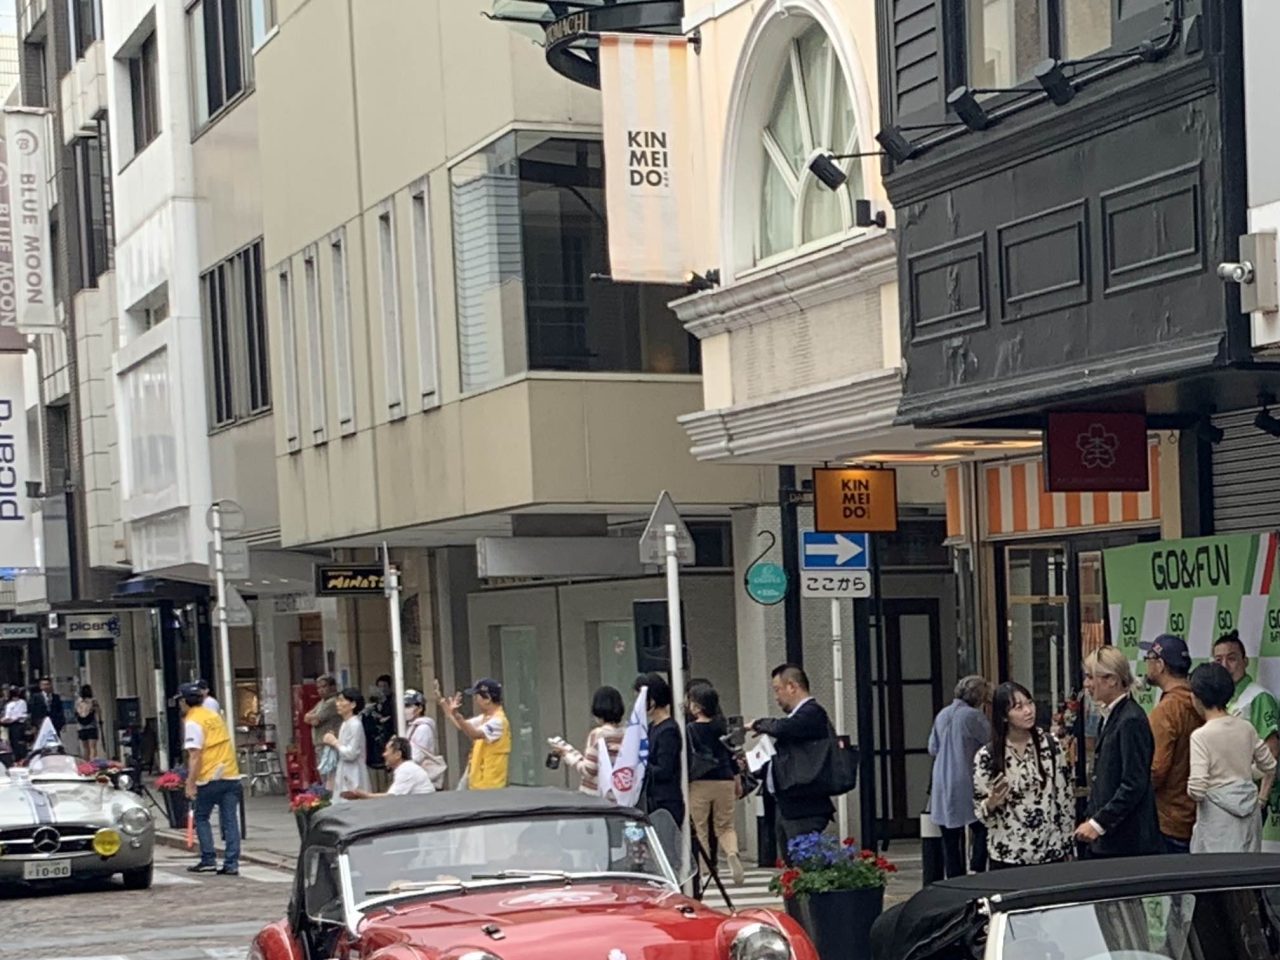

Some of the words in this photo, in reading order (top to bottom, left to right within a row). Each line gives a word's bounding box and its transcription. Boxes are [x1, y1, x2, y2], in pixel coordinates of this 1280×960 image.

[627, 131, 667, 148] KIN
[629, 151, 668, 168] MEI
[630, 170, 662, 187] DO
[20, 173, 38, 225] BLUE
[24, 235, 44, 304] MOON
[0, 261, 15, 327] MOON
[841, 479, 869, 492] KIN
[842, 493, 870, 505] MEI
[843, 506, 866, 519] DO
[1151, 544, 1231, 591] GO&FUN
[806, 577, 866, 591] ここから
[1122, 616, 1137, 635] GO
[1169, 613, 1185, 632] GO
[1217, 609, 1233, 630] GO
